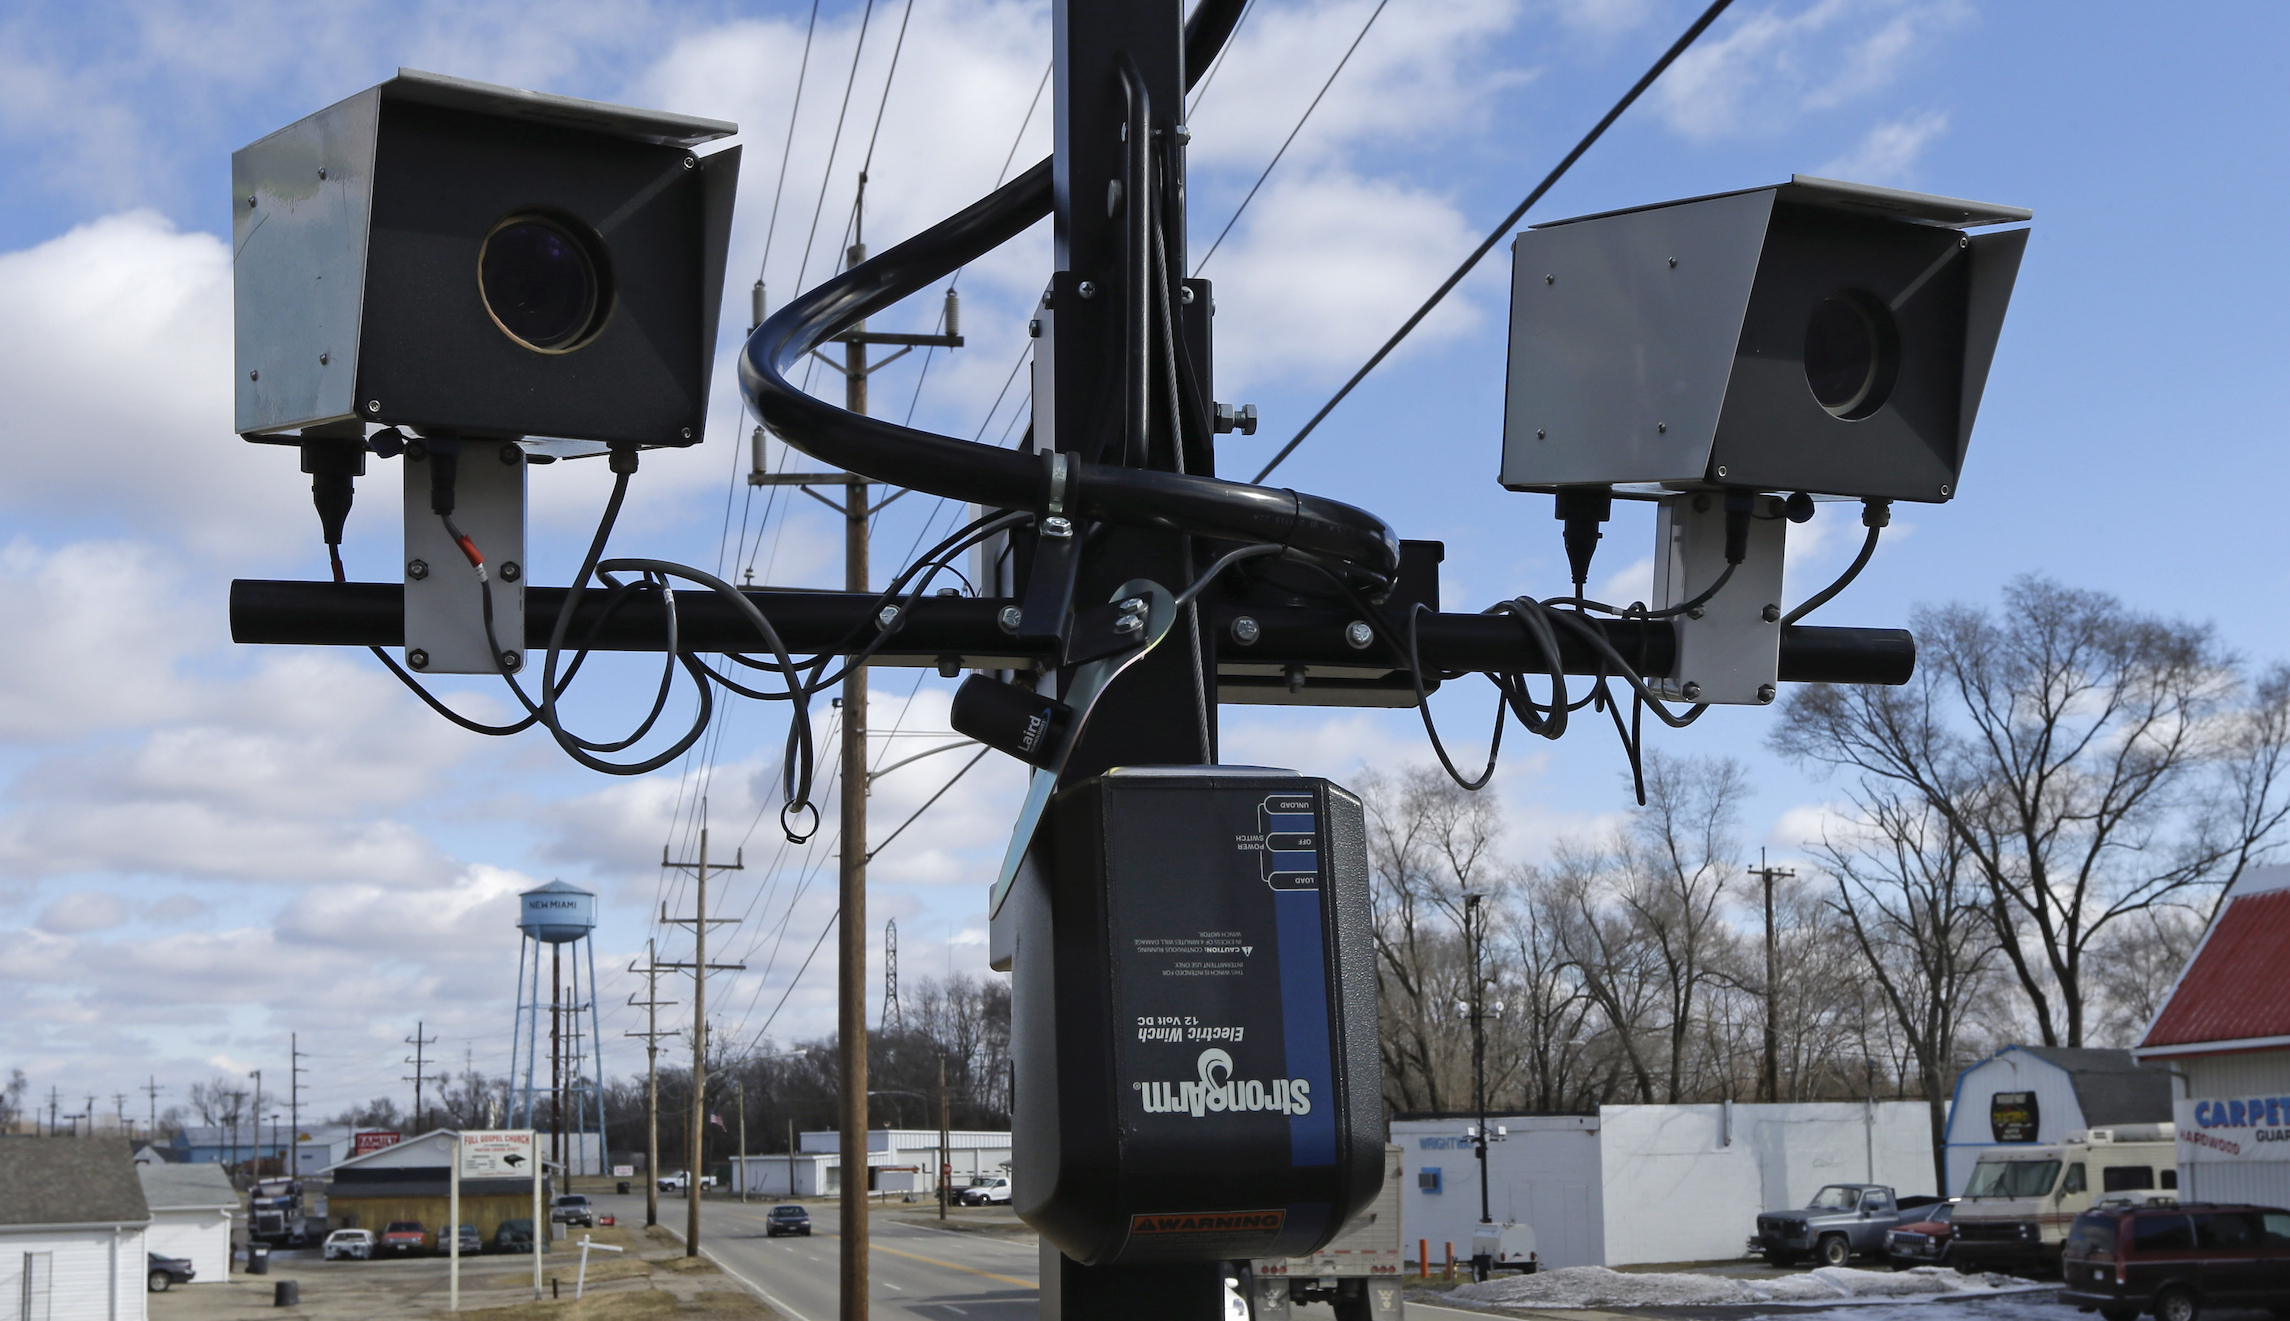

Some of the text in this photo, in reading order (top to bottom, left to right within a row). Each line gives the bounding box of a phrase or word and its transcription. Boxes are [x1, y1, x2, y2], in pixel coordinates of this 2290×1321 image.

[1018, 715, 1041, 752] Laird
[1137, 1016, 1199, 1025] 12 Volt DC
[1138, 1026, 1244, 1042] Electric Winch
[464, 1136, 478, 1145] FULL
[505, 1135, 530, 1144] CHURCH
[2180, 1129, 2240, 1155] HARDWOOD
[1158, 1215, 1278, 1230] WARNING
